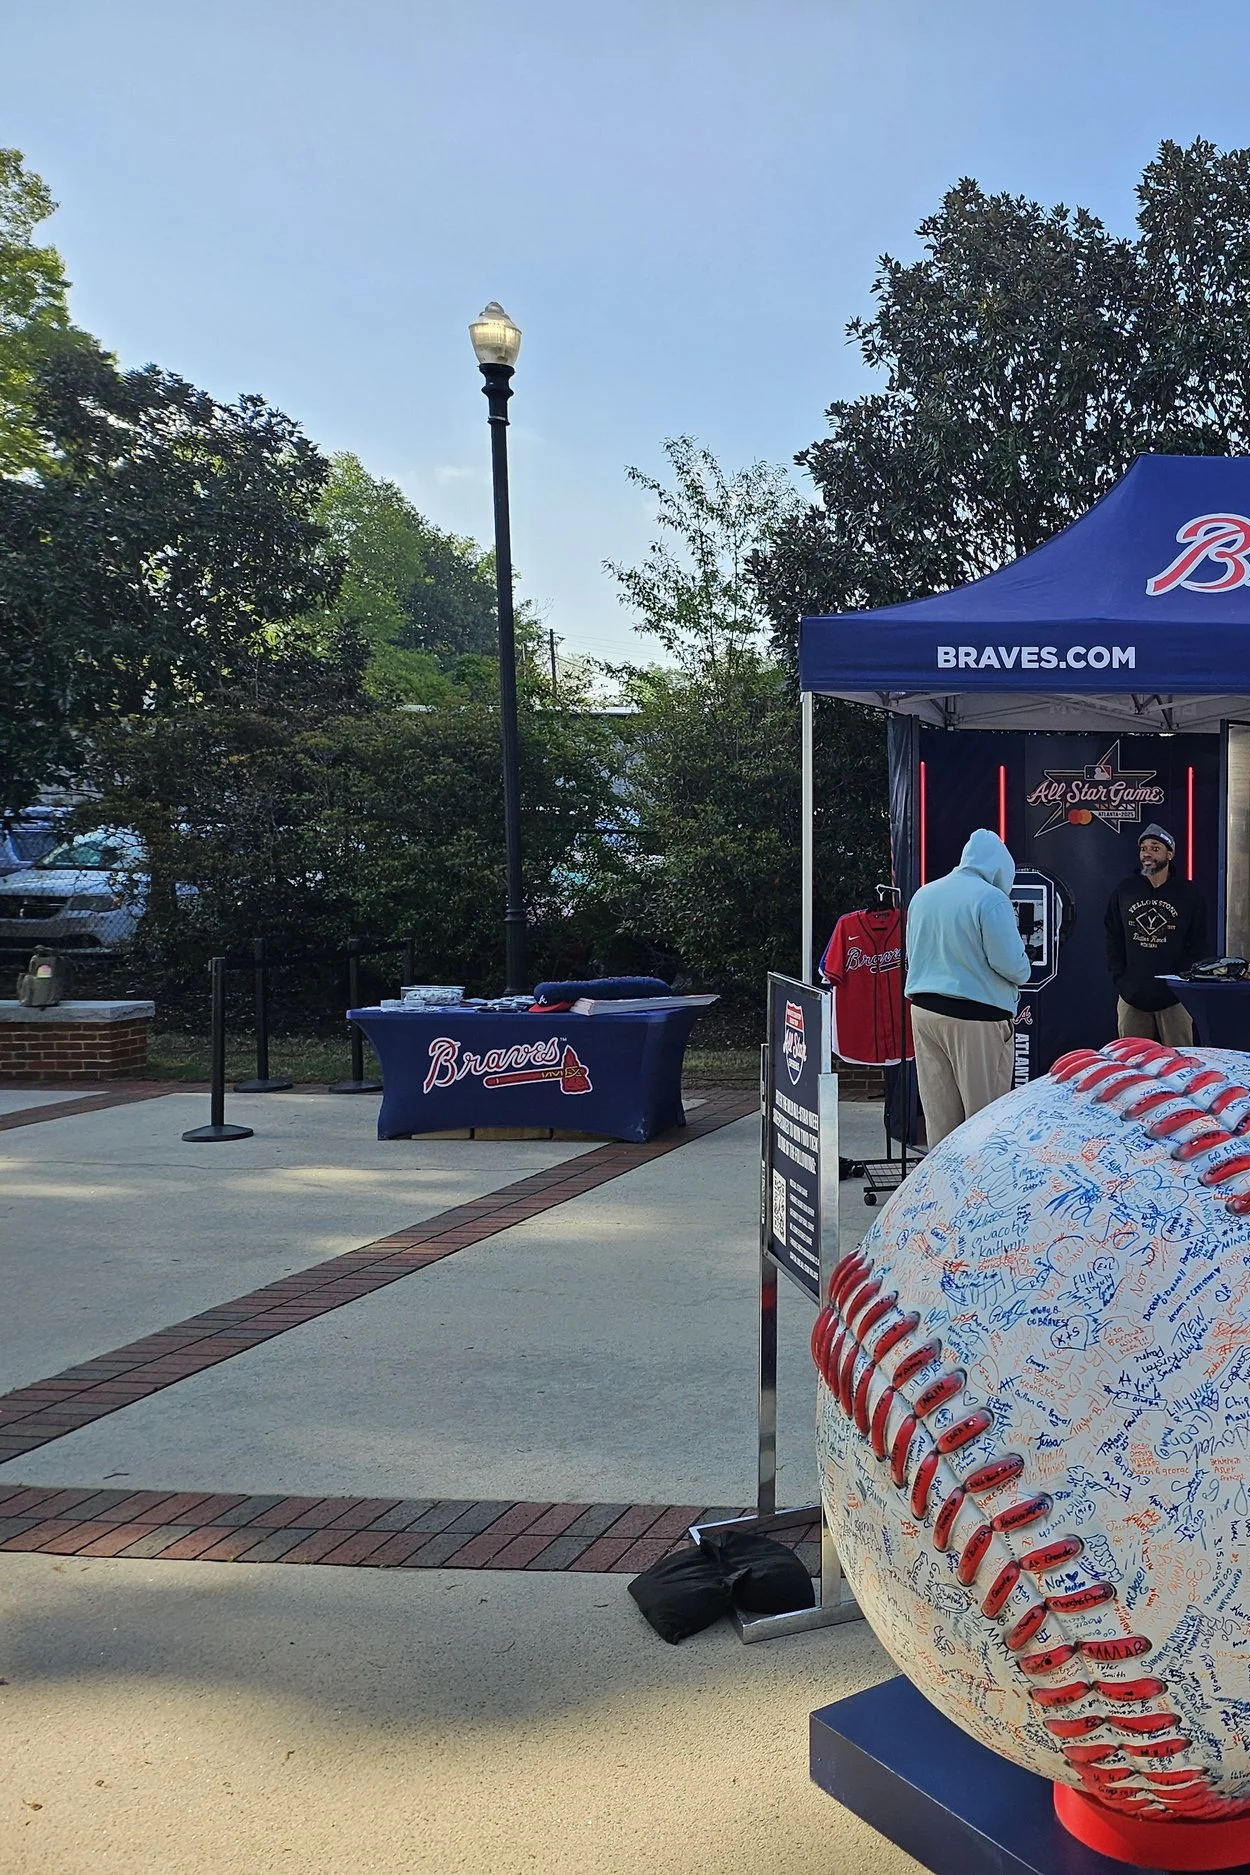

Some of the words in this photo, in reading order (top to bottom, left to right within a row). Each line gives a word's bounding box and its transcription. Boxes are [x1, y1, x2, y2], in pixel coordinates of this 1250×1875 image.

[937, 646, 1136, 669] BRAVES.COM
[1026, 780, 1067, 803] All
[1066, 781, 1107, 803] Star
[1107, 781, 1162, 805] Game
[1128, 900, 1178, 917] YELLOWSTONE
[423, 1037, 558, 1094] Braves
[1015, 1032, 1029, 1088] ATLANT
[1225, 1396, 1249, 1409] Chip
[1095, 1663, 1119, 1672] Tyler
